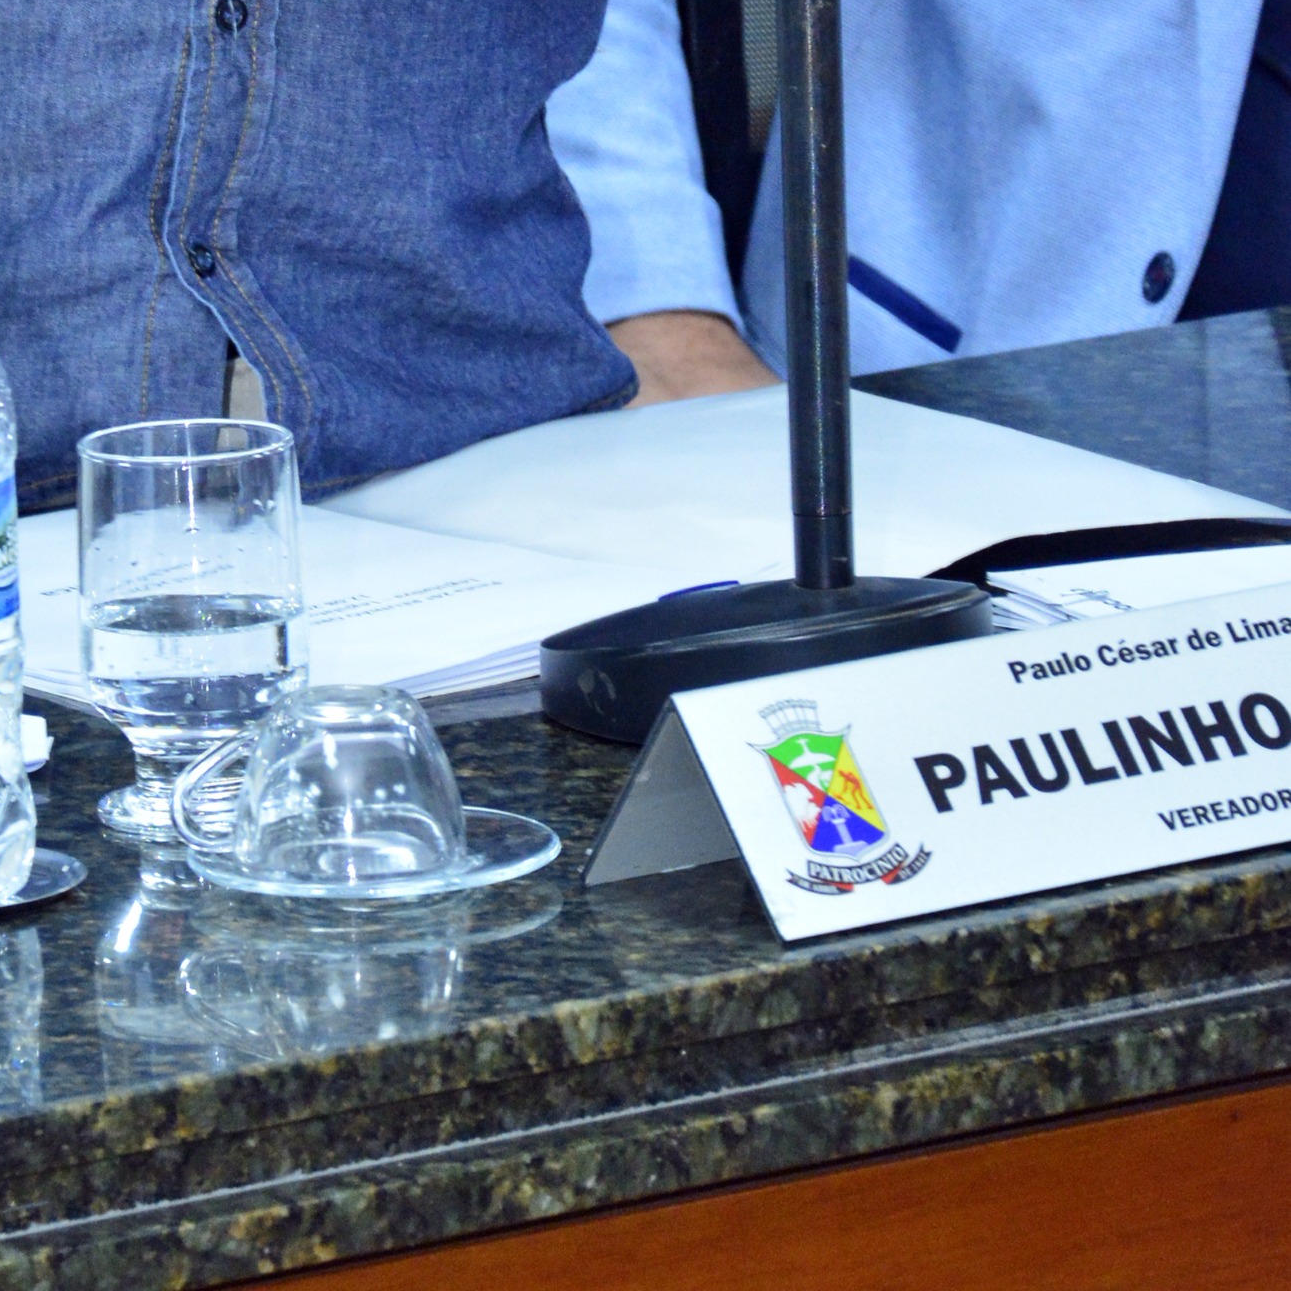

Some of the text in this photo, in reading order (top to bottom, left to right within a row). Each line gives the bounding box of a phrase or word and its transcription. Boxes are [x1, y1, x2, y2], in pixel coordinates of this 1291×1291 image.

[1008, 616, 1291, 684] Paulo César de Lima
[913, 691, 1291, 814] PAULINHO
[1157, 788, 1291, 832] VEREADOR
